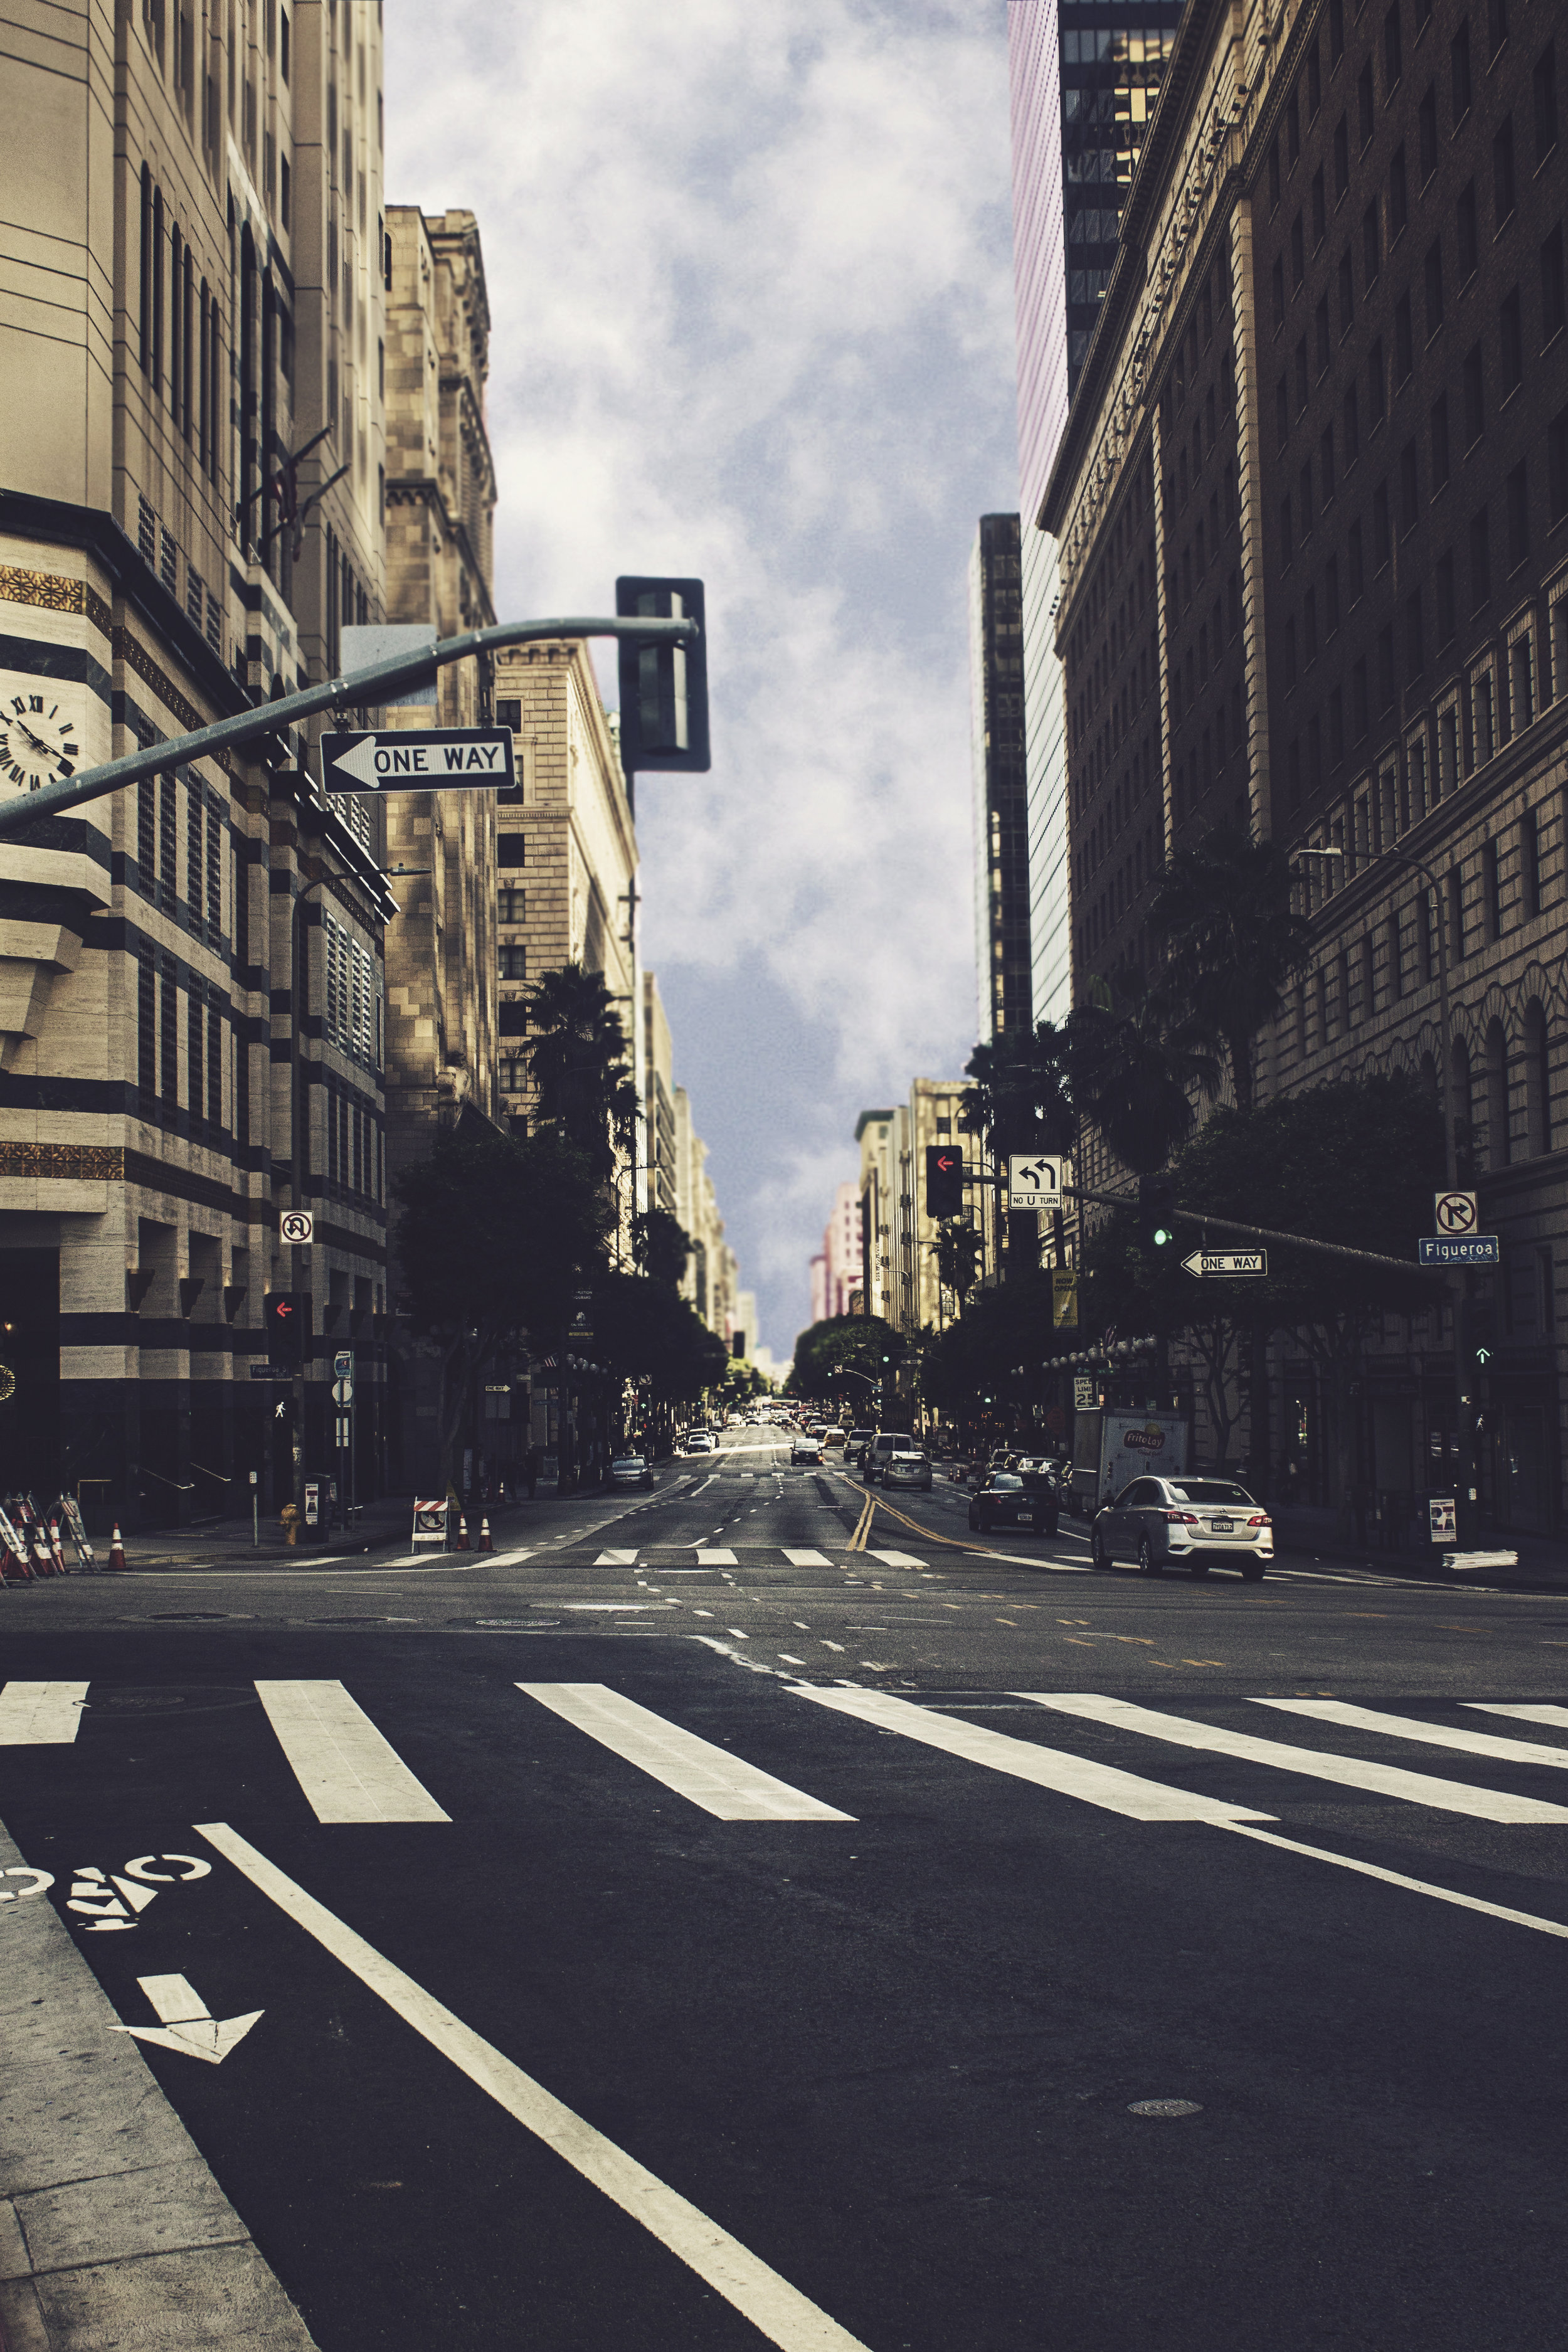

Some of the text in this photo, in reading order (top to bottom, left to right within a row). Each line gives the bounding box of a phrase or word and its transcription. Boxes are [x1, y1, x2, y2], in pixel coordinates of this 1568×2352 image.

[63, 743, 78, 756] III
[374, 746, 499, 773] ONE WAY
[1027, 1195, 1036, 1205] U
[1426, 1244, 1493, 1260] Figueroa
[1200, 1257, 1259, 1270] ONE WAY
[252, 1365, 279, 1374] Figueroa
[1076, 1393, 1093, 1406] 25
